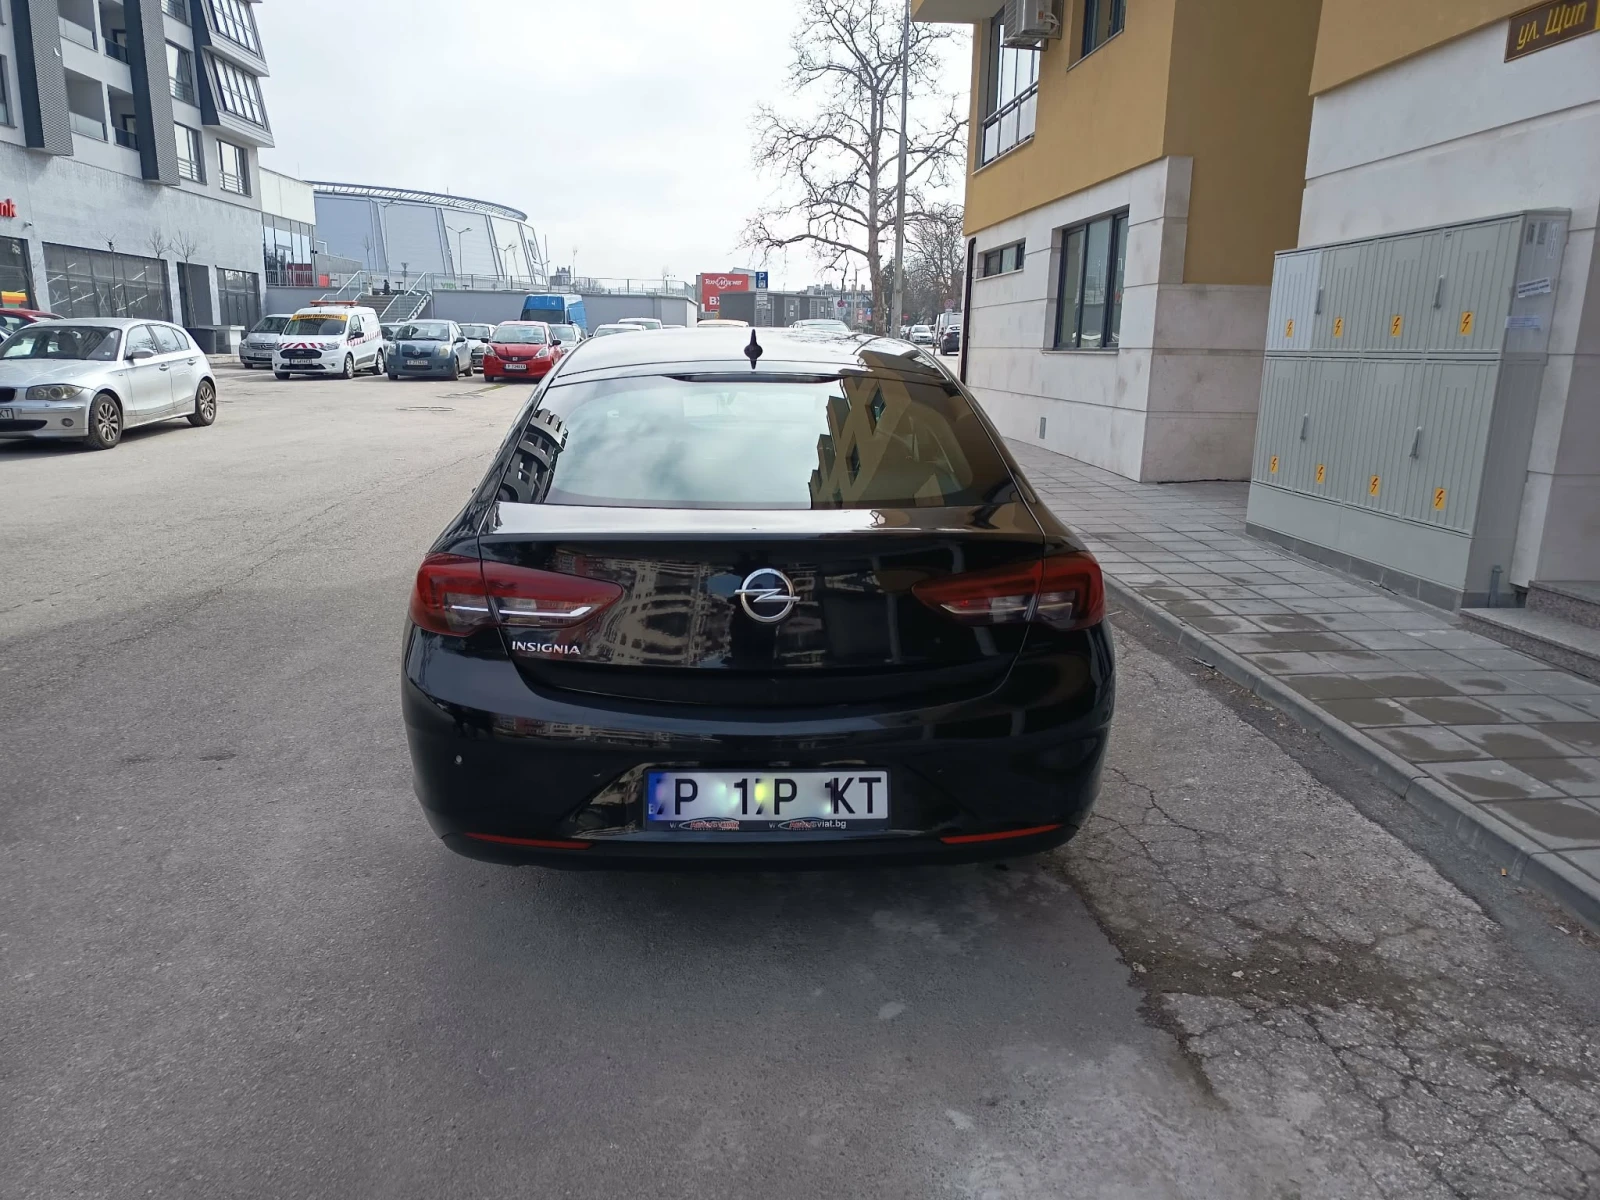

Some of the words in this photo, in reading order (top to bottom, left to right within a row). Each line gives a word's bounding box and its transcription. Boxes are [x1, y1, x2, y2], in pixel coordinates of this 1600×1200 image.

[1516, 20, 1540, 50] ул.
[1544, 2, 1587, 36] Щип
[511, 640, 581, 655] INSIGNIA
